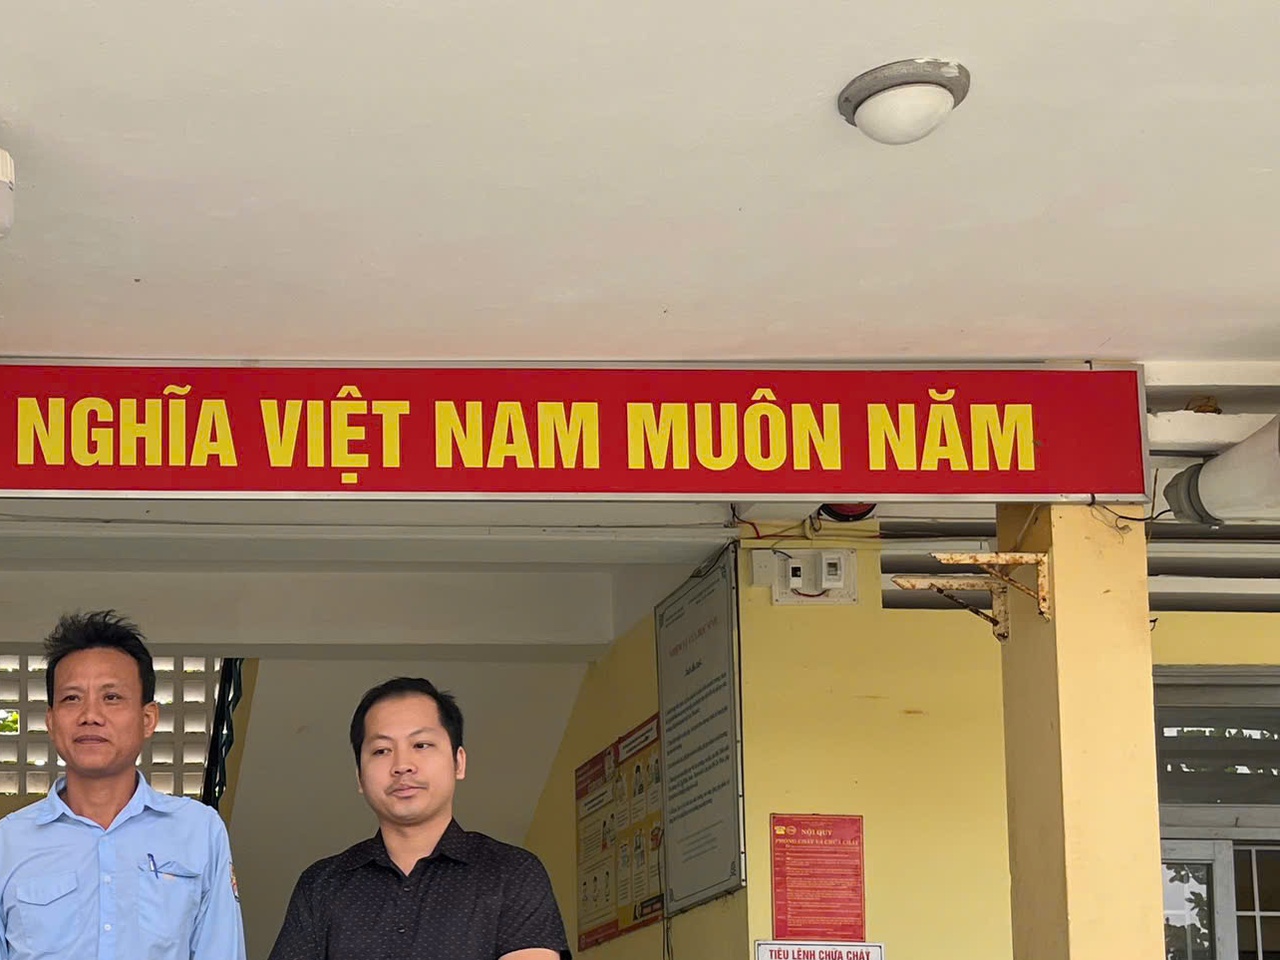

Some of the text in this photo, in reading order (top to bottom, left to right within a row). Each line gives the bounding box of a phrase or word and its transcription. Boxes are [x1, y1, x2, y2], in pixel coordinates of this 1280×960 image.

[17, 386, 236, 469] NGHĨA
[263, 386, 410, 485] VIỆT
[434, 402, 600, 471] NAM
[628, 389, 841, 471] MUÔN
[867, 389, 1035, 472] NĂM
[769, 948, 789, 960] TIÊU
[818, 948, 843, 960] CHỮA
